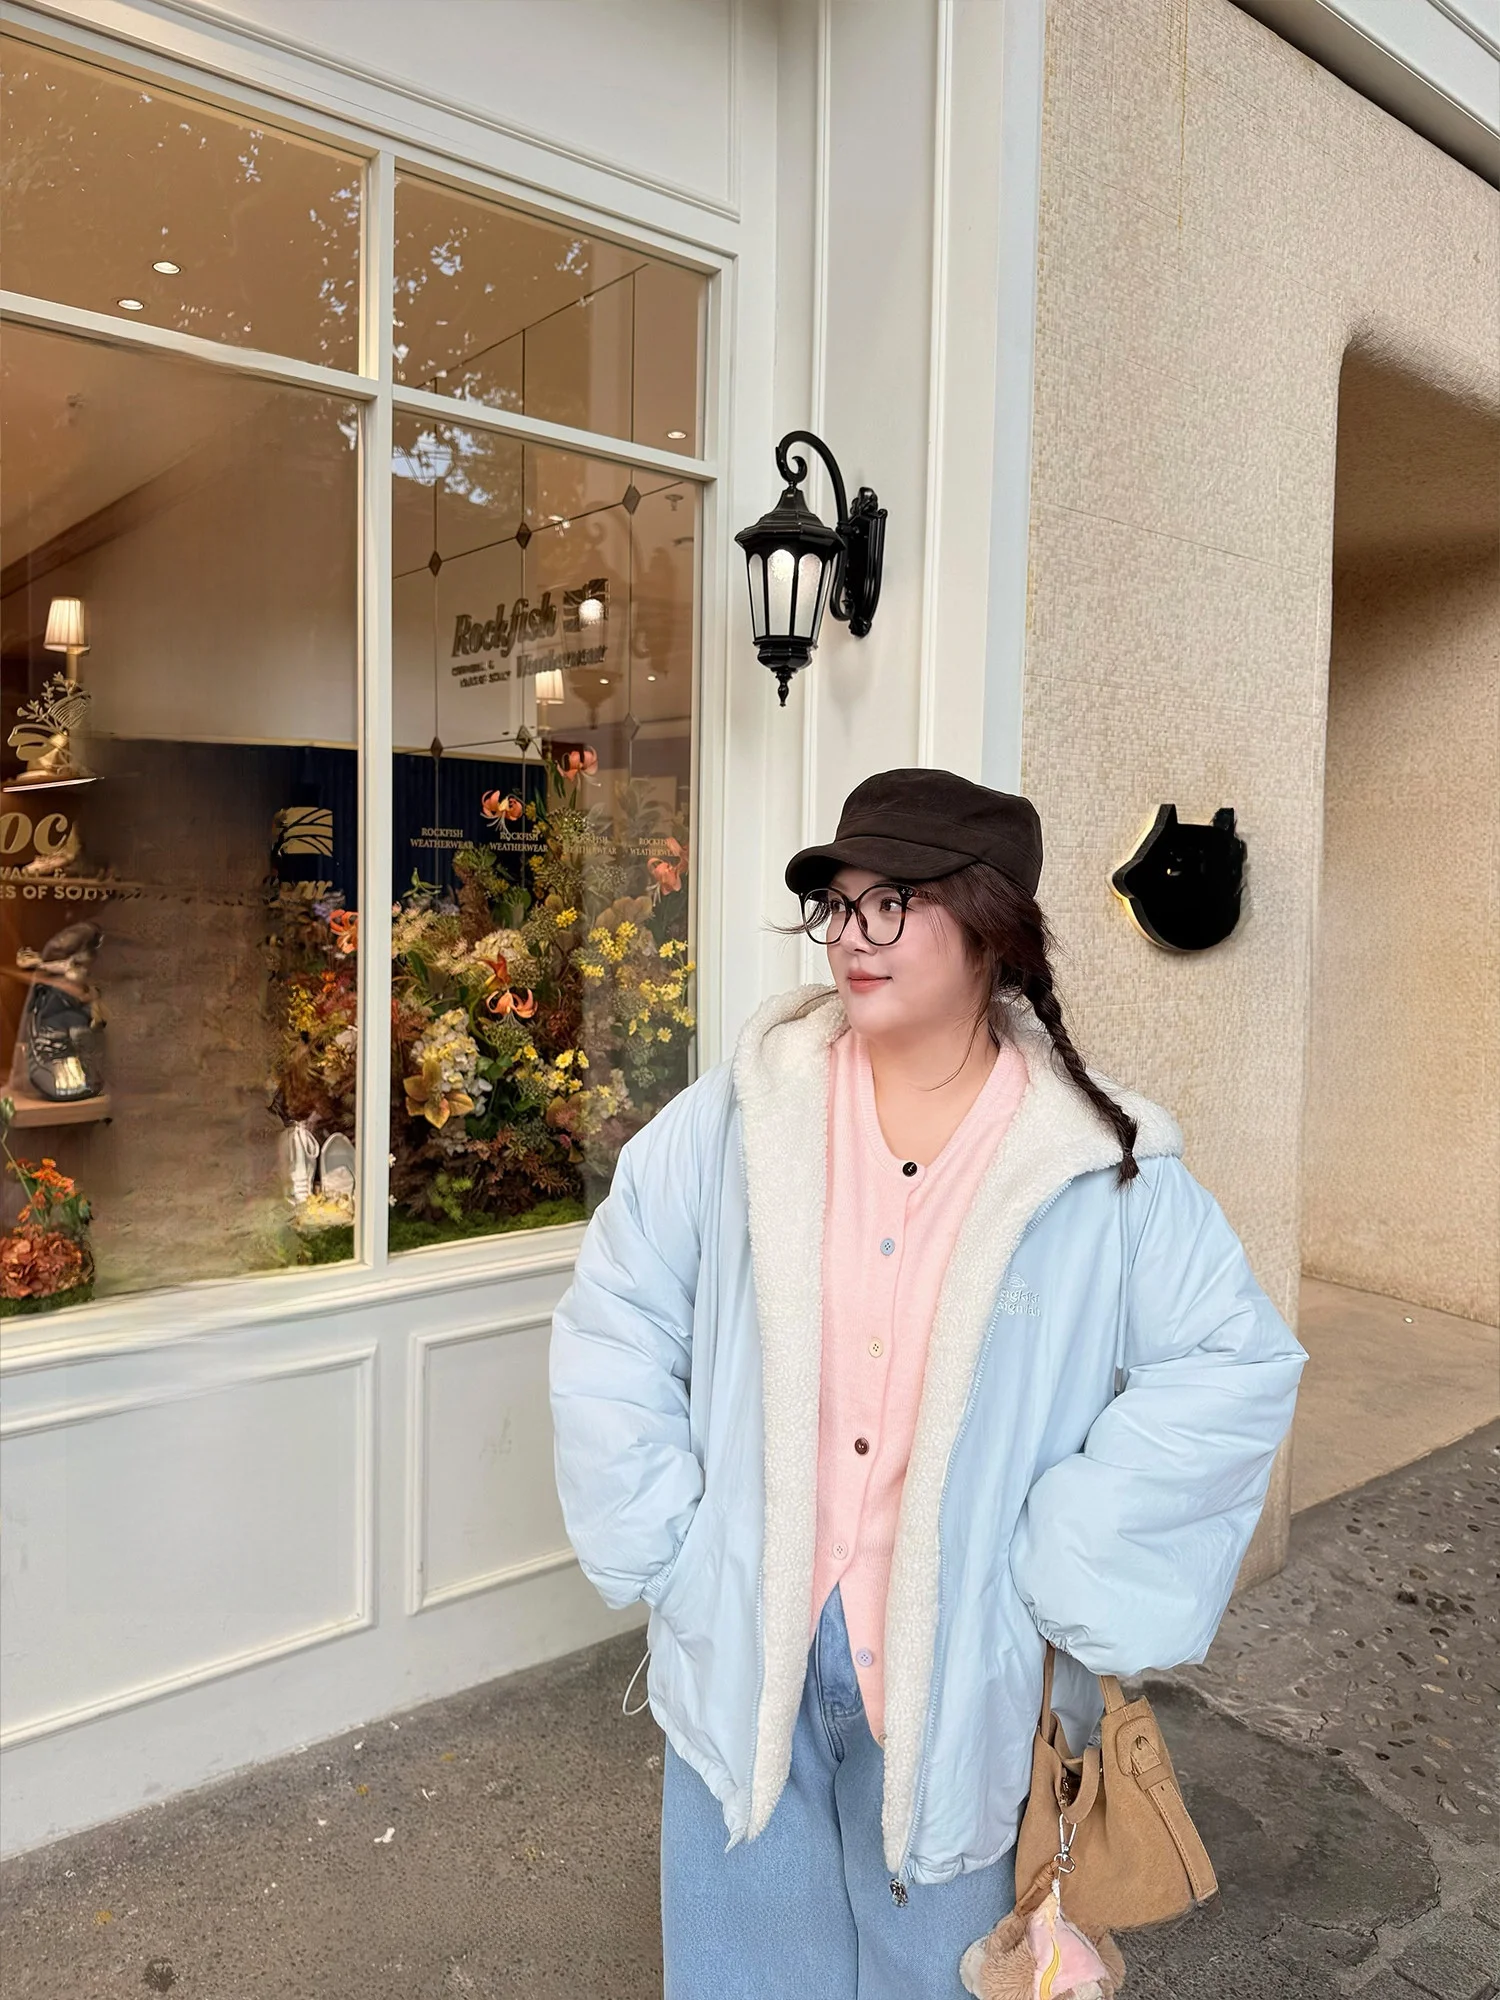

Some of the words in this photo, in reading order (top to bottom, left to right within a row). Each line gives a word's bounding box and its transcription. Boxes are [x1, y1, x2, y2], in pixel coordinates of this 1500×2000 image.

[452, 592, 557, 657] Rockfish
[421, 827, 463, 838] ROCKFISH
[410, 838, 474, 850] WEATHERWEAR
[489, 842, 548, 853] WEATHERWEAR
[22, 885, 48, 900] OF
